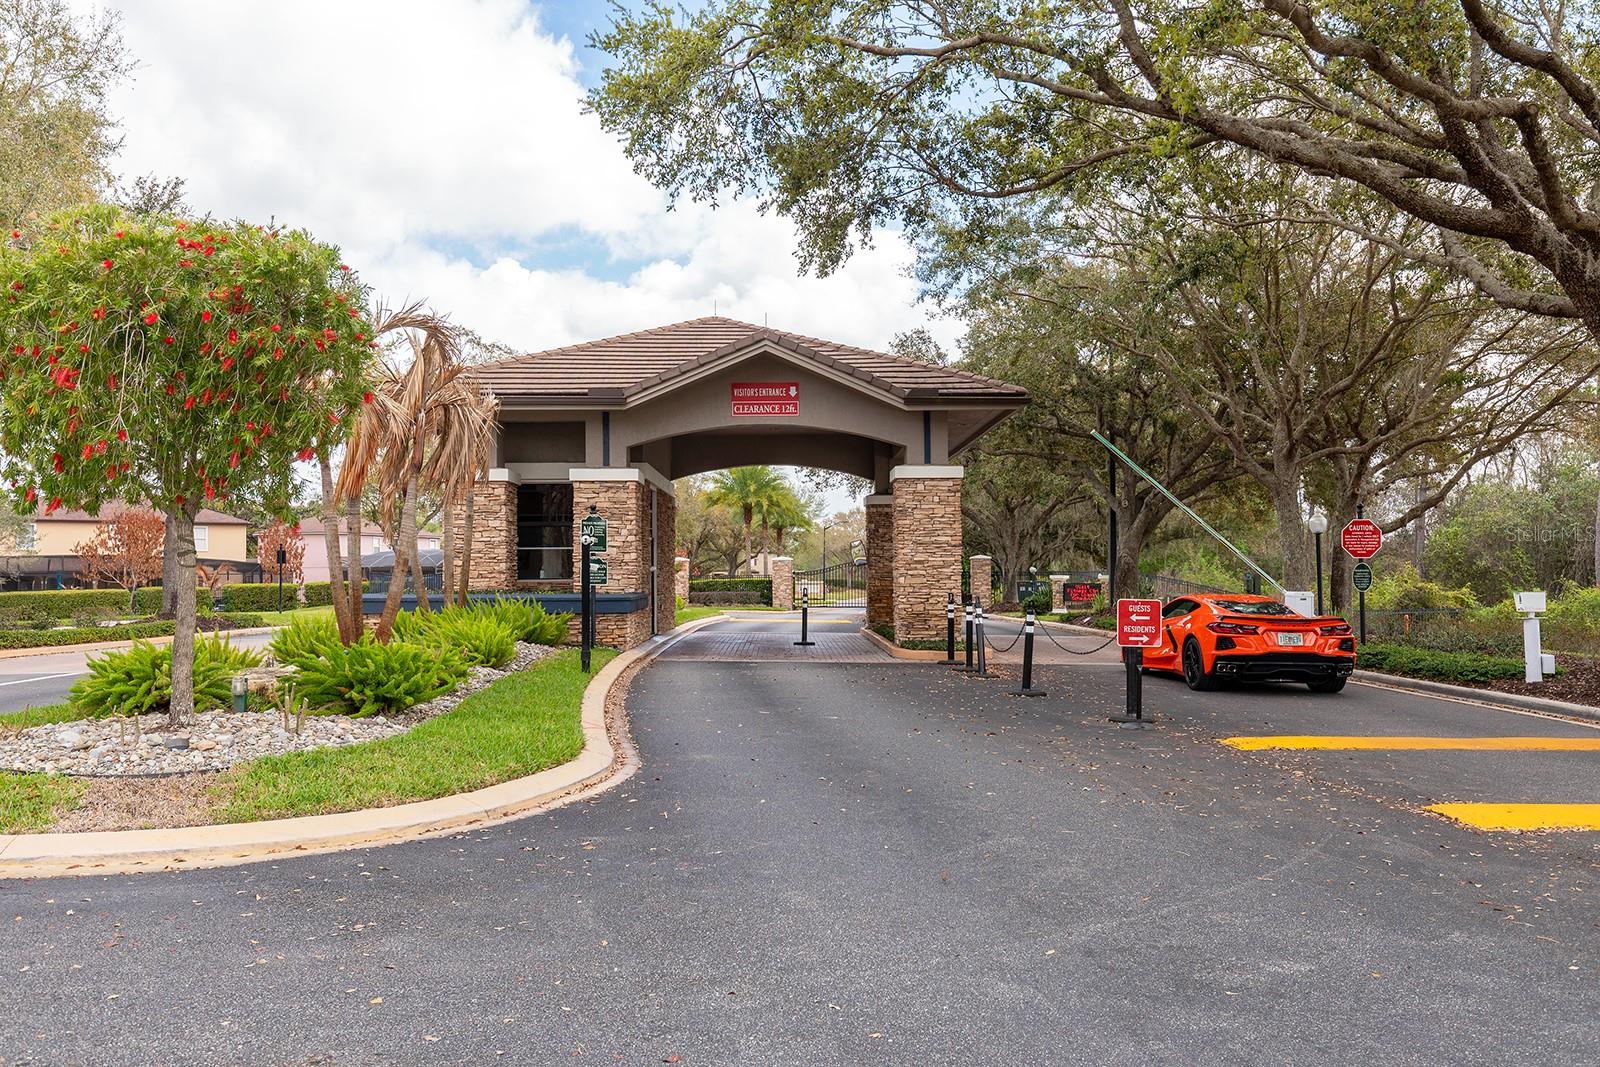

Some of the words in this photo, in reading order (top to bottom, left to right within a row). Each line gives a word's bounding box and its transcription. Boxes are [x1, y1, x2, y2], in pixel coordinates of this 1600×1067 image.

[759, 388, 786, 397] ENTRANCE
[734, 404, 780, 414] CLEARANCE
[1128, 604, 1151, 613] GUESTS
[1123, 625, 1156, 634] RESIDENTS
